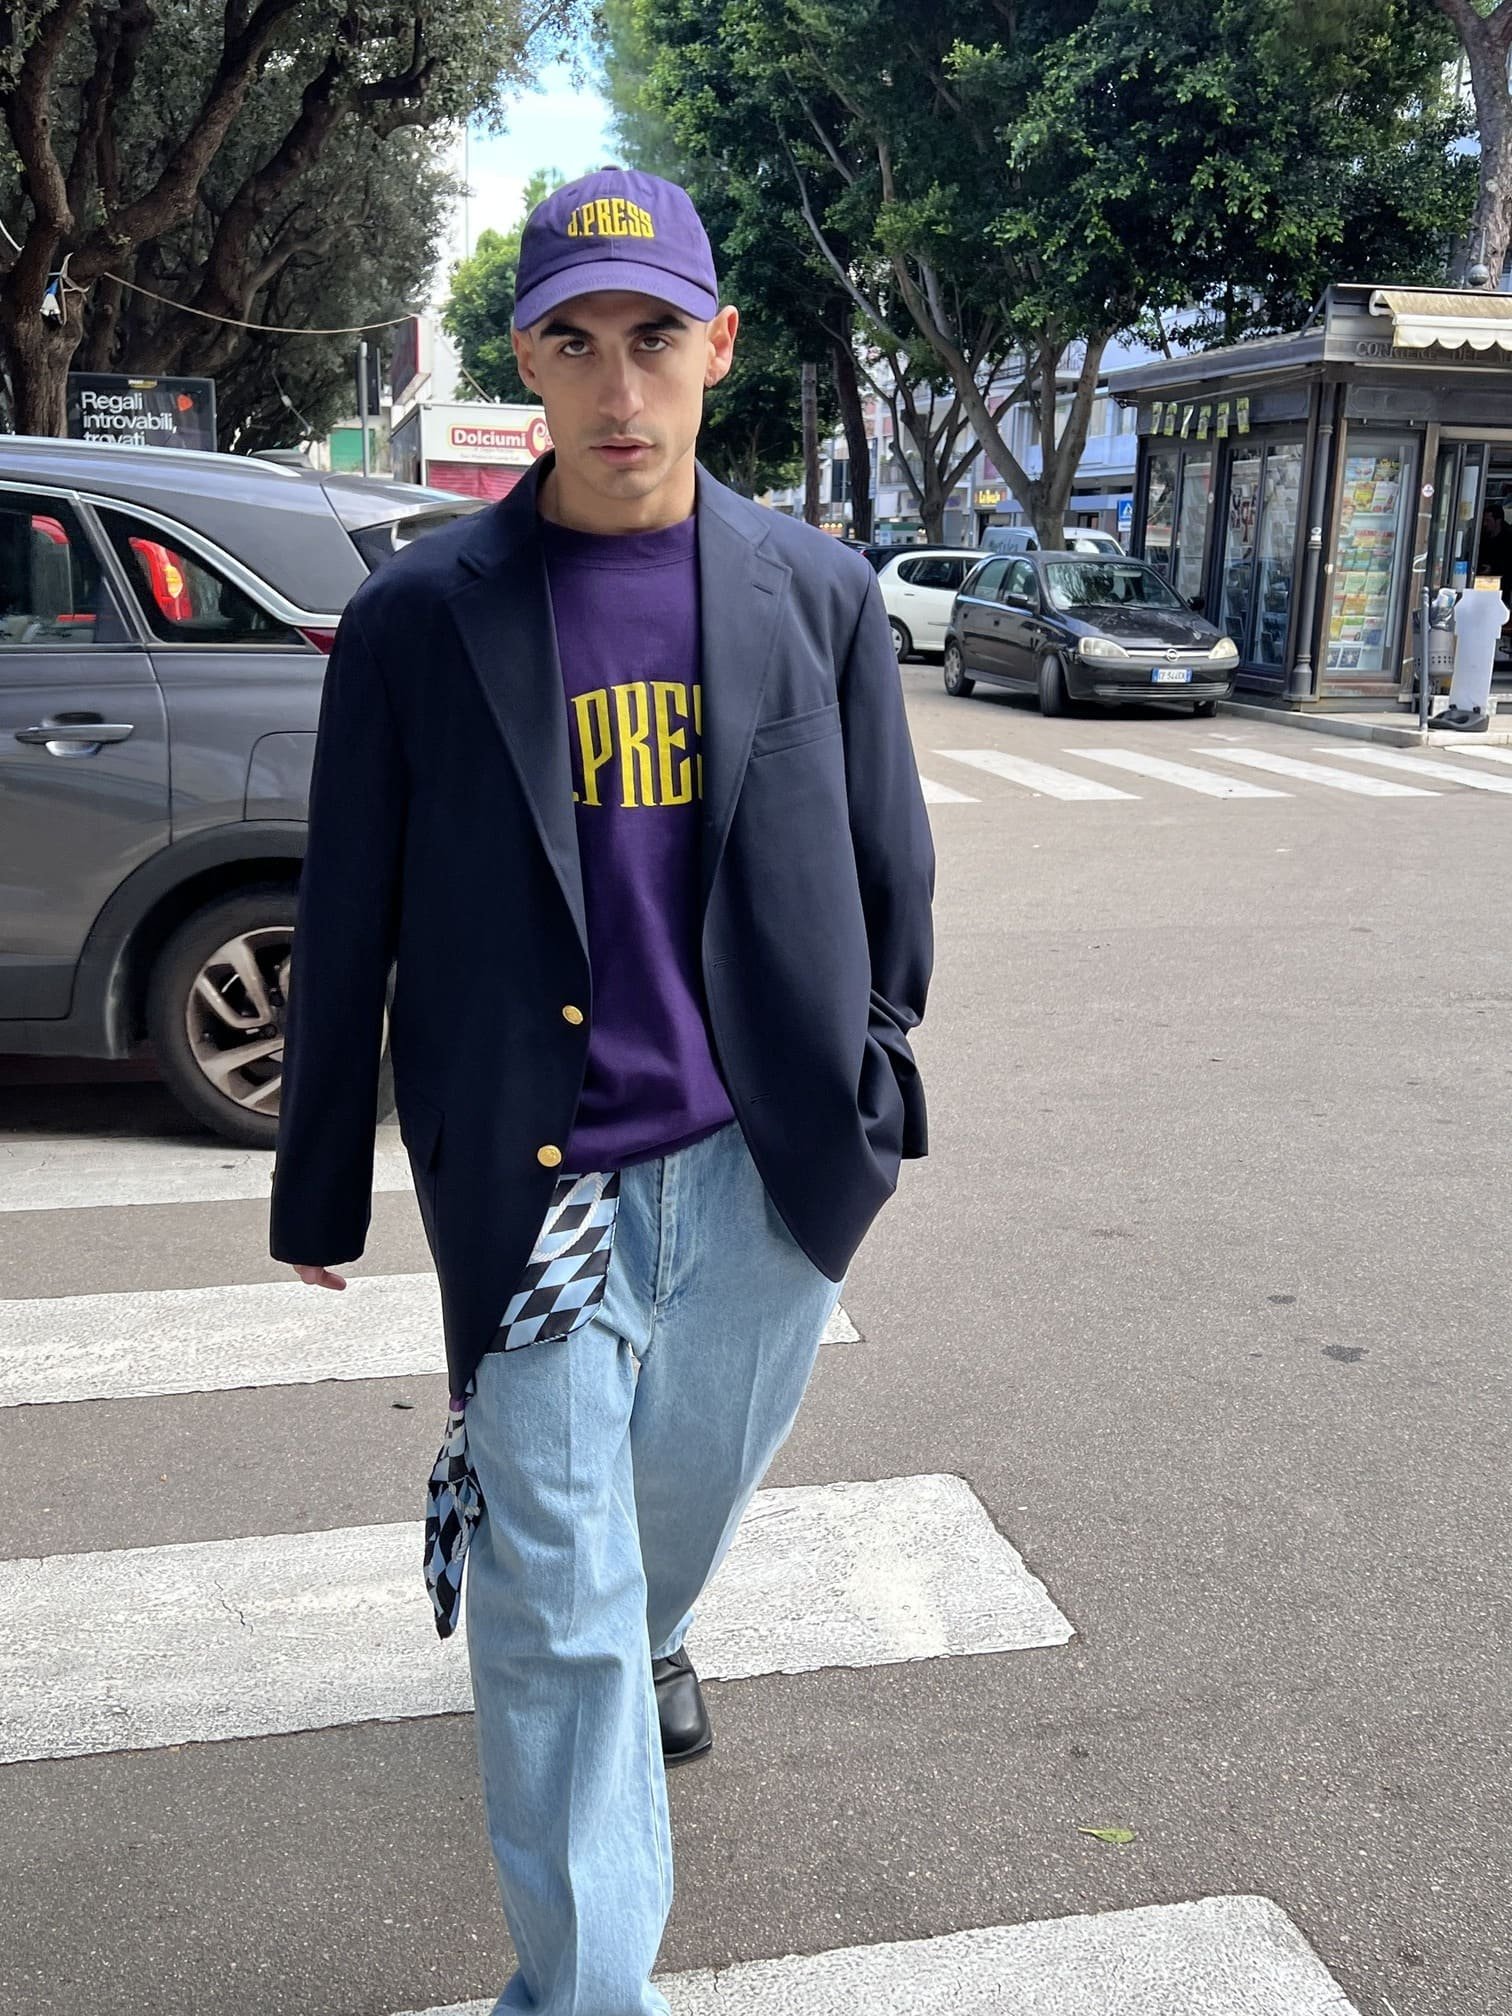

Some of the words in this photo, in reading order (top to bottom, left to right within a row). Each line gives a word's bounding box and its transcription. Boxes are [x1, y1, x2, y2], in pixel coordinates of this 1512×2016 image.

[81, 391, 143, 413] Regali
[83, 412, 177, 434] introvabili,
[453, 429, 526, 447] Dolciumi
